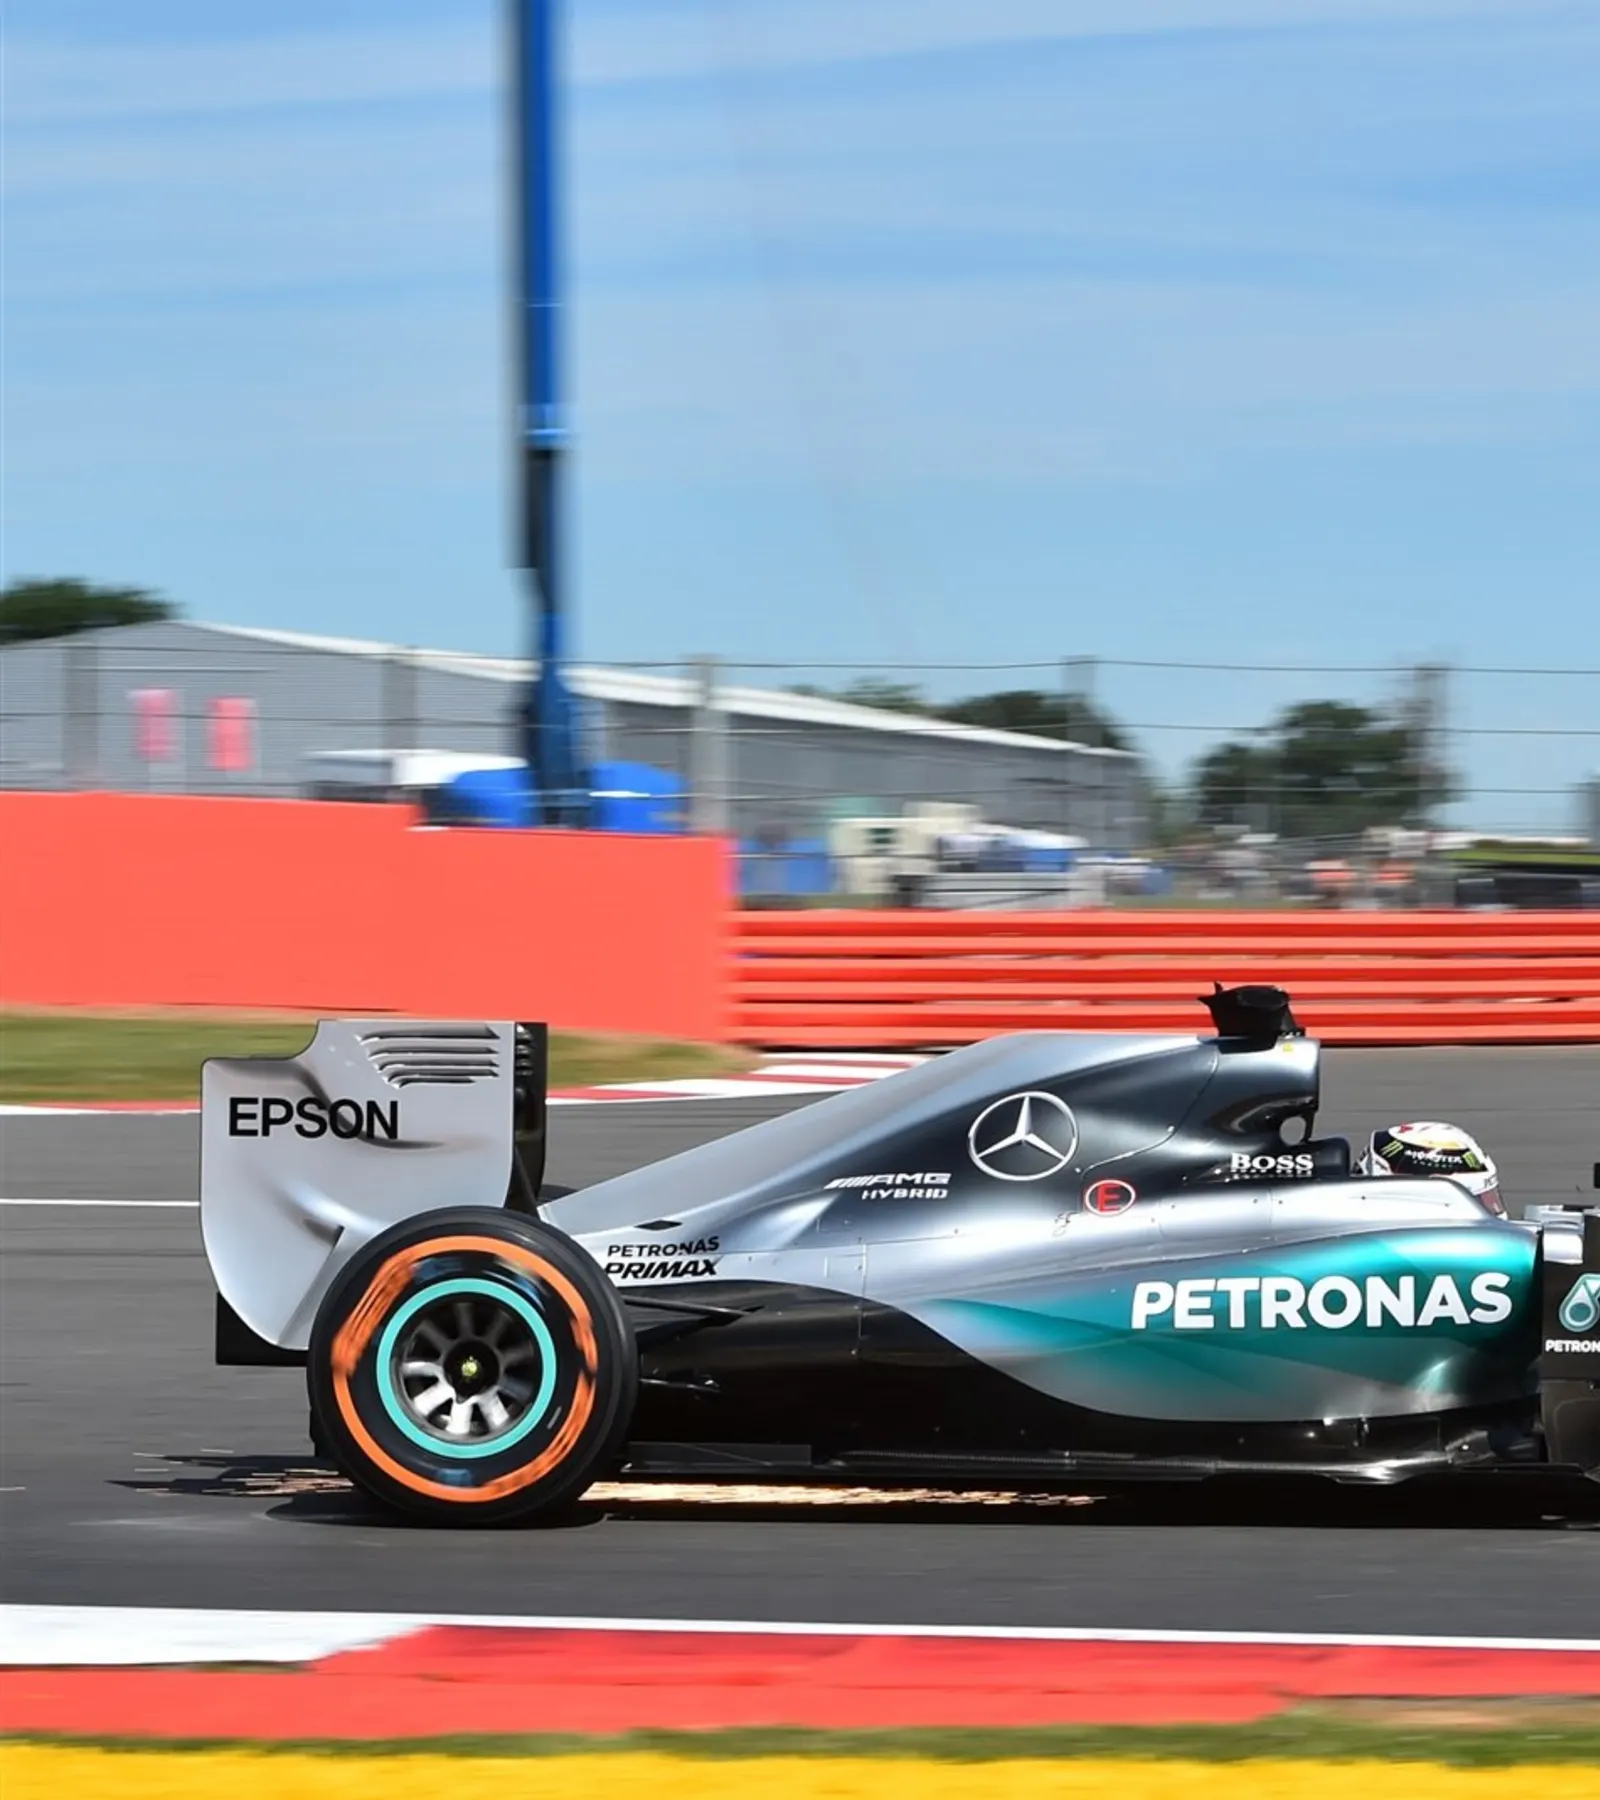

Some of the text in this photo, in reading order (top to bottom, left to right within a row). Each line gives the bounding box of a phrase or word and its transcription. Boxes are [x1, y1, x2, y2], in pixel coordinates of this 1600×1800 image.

[229, 1097, 398, 1139] EPSON
[1231, 1153, 1314, 1170] BOSS
[869, 1172, 951, 1186] AMG
[861, 1188, 948, 1200] HYBRID
[1097, 1183, 1121, 1212] E
[607, 1235, 719, 1257] PETRONAS
[605, 1259, 716, 1279] PRIMAX
[1131, 1272, 1512, 1329] PETRONAS
